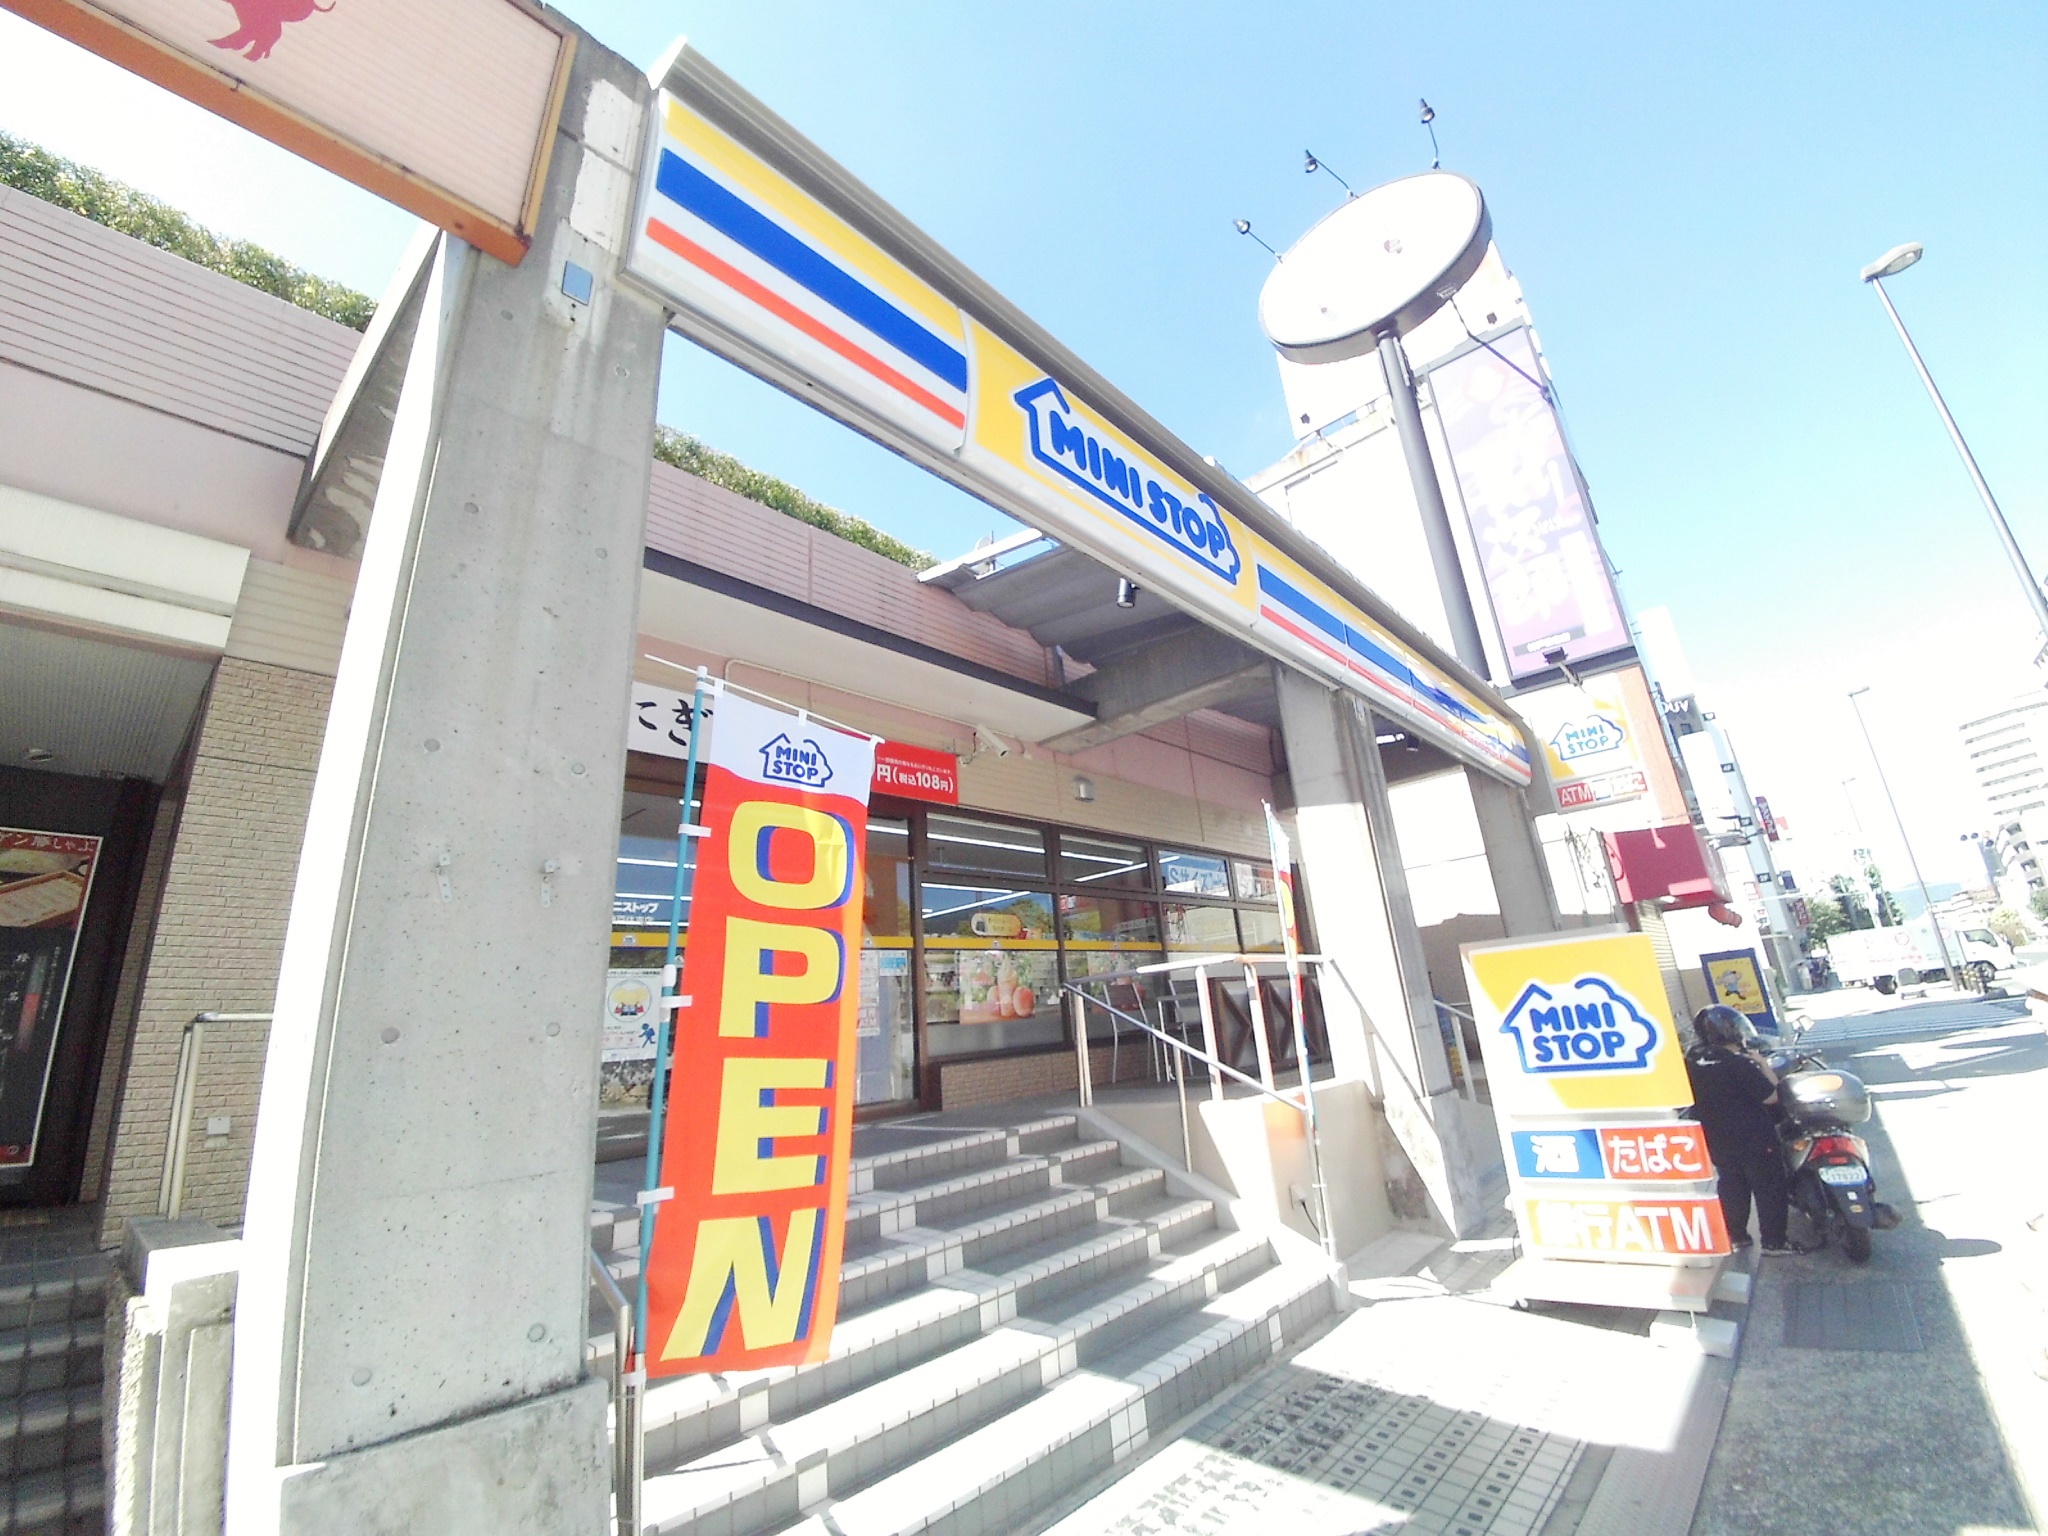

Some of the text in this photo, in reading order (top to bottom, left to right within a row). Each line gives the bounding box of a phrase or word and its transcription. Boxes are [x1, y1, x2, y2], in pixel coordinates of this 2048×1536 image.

[1050, 410, 1226, 559] MINI STOP
[1565, 724, 1604, 741] MINI
[1568, 735, 1609, 754] STOP
[776, 745, 817, 766] MINI
[772, 759, 819, 780] STOP
[1562, 784, 1594, 805] ATM
[1530, 1002, 1616, 1034] MINI
[1533, 1031, 1625, 1063] STOP
[659, 800, 854, 1363] OPEN
[1608, 1133, 1702, 1174] たばこ
